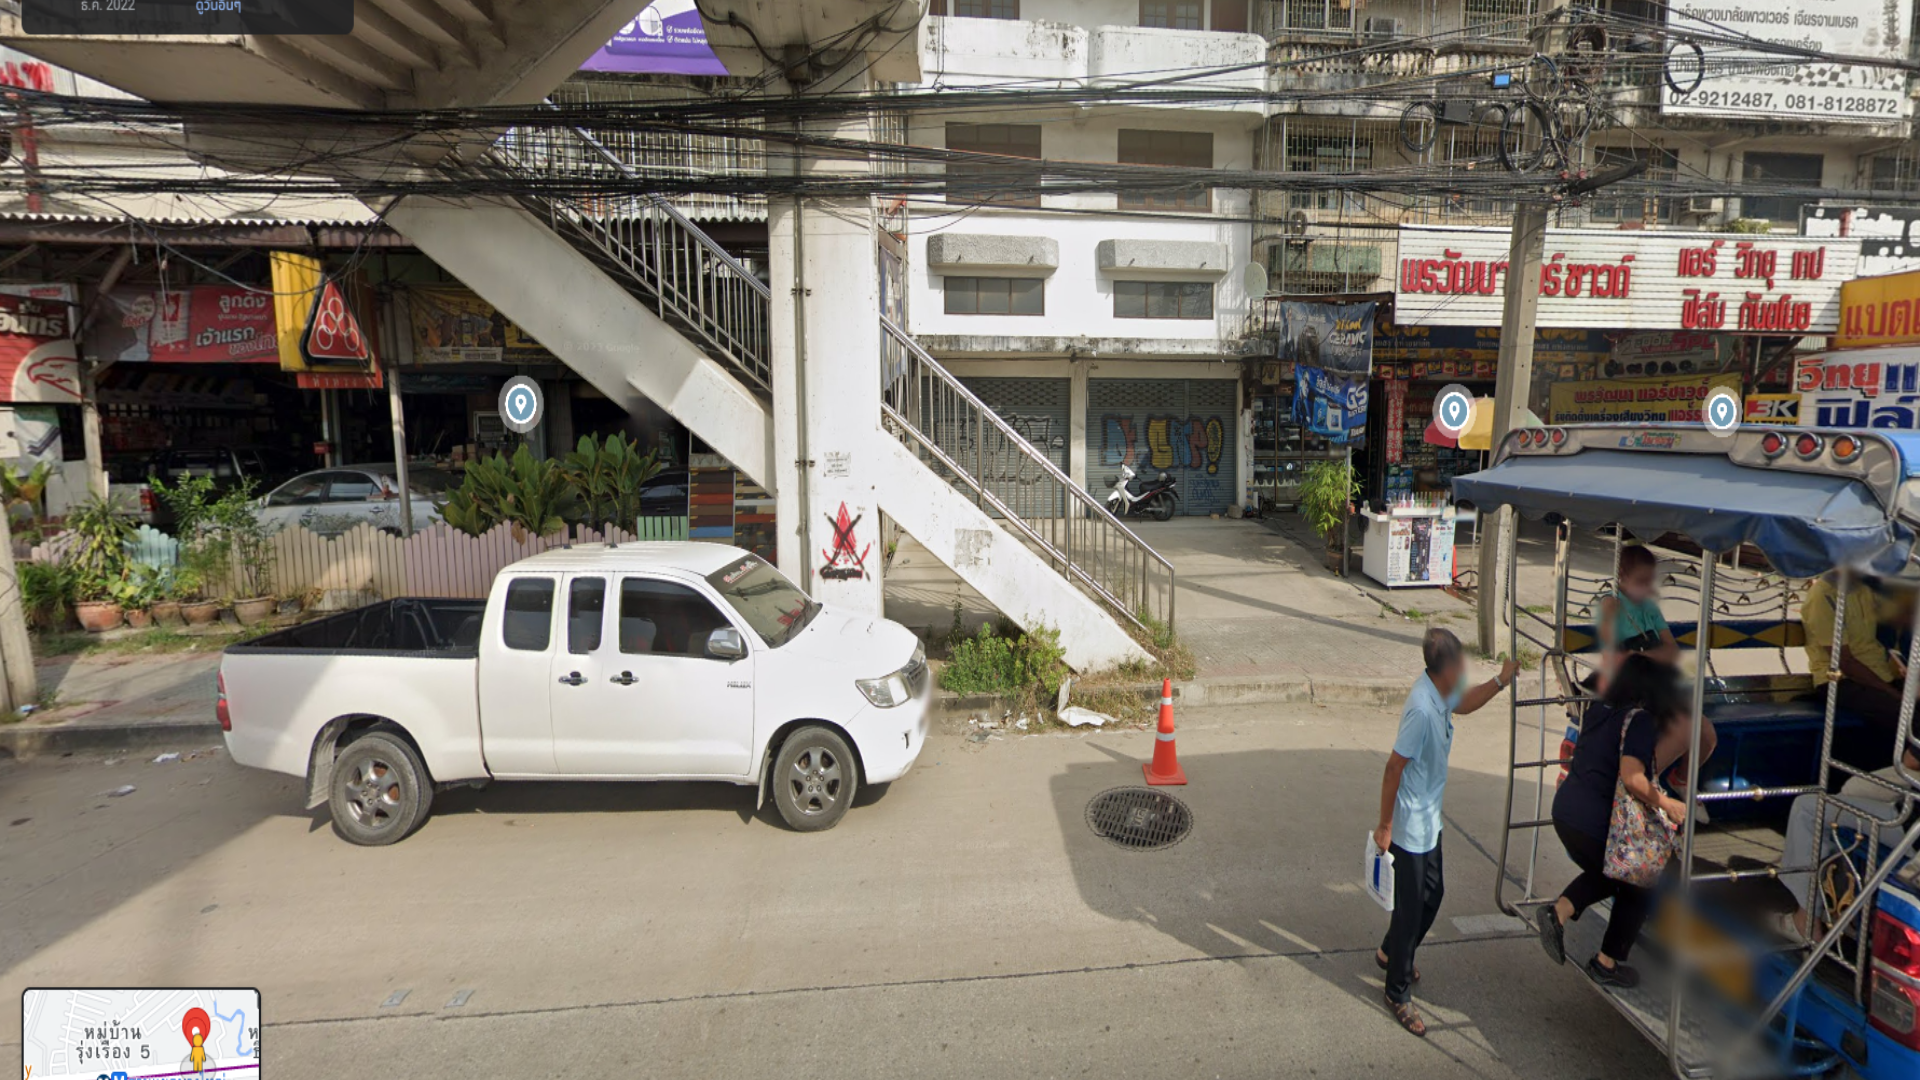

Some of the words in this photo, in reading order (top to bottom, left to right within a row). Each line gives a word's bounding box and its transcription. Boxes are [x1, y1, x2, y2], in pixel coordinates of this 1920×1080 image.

[1669, 91, 1777, 110] 02-9212487,
[1785, 94, 1898, 114] 081-8128872
[1538, 253, 1635, 298] ร์ซาวด์
[1679, 240, 1725, 277] แอร์
[1735, 243, 1777, 290] วิทยุ
[1792, 247, 1826, 280] เทป
[1682, 289, 1726, 329] ฟิล์ม
[1739, 291, 1811, 330] กันขโมย
[196, 327, 255, 347] เจ้าแรก
[1799, 358, 1880, 398] วิทยุ
[1816, 396, 1920, 428] ฟิล์
